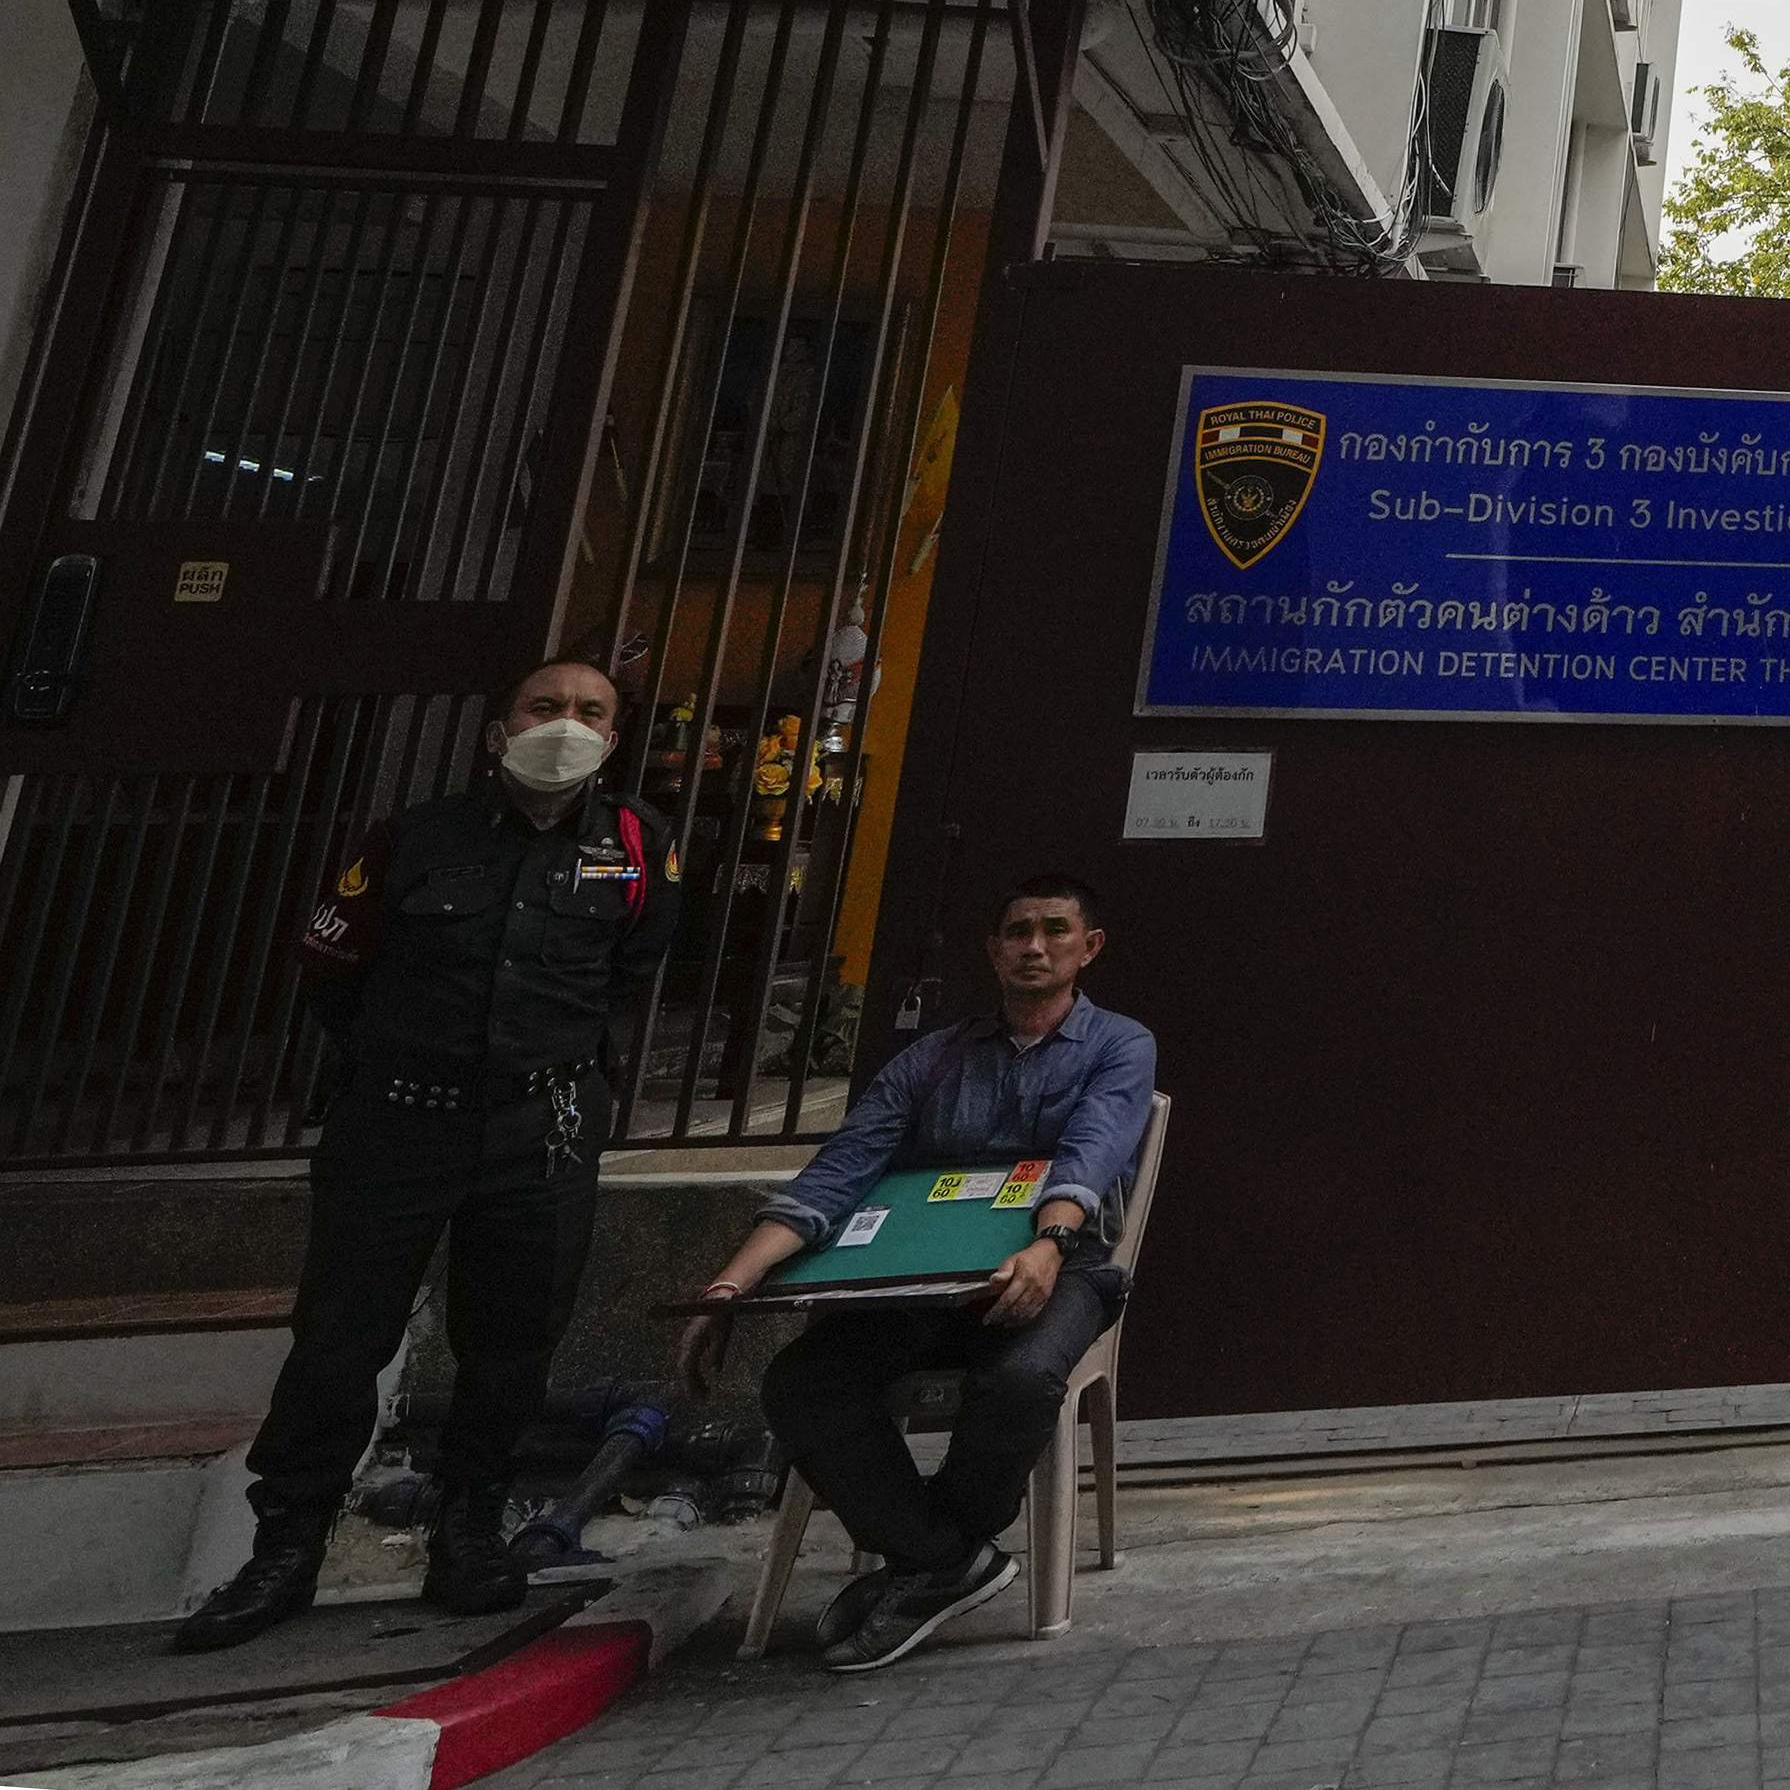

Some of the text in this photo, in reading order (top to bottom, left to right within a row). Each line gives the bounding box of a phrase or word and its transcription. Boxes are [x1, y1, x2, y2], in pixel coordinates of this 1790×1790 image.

[1210, 409, 1316, 430] ROYAL THAI POLICE
[1204, 443, 1311, 464] IMMIGRATION BUREAU
[1338, 419, 1573, 468] กองกำกับการ
[1584, 436, 1606, 470] 3
[1368, 489, 1614, 528] Sub-Division
[1629, 498, 1652, 529] 3
[182, 566, 223, 582] ผลัก
[179, 583, 221, 595] PUSH
[1185, 580, 1660, 635] สถานกักตัวคนต่างด้าว
[1190, 645, 1424, 676] IMMIGRATION
[1438, 650, 1616, 680] DETENTION
[1629, 655, 1747, 683] CENTER
[932, 1188, 950, 1198] 60
[1006, 1184, 1022, 1193] 10
[999, 1195, 1017, 1204] 60
